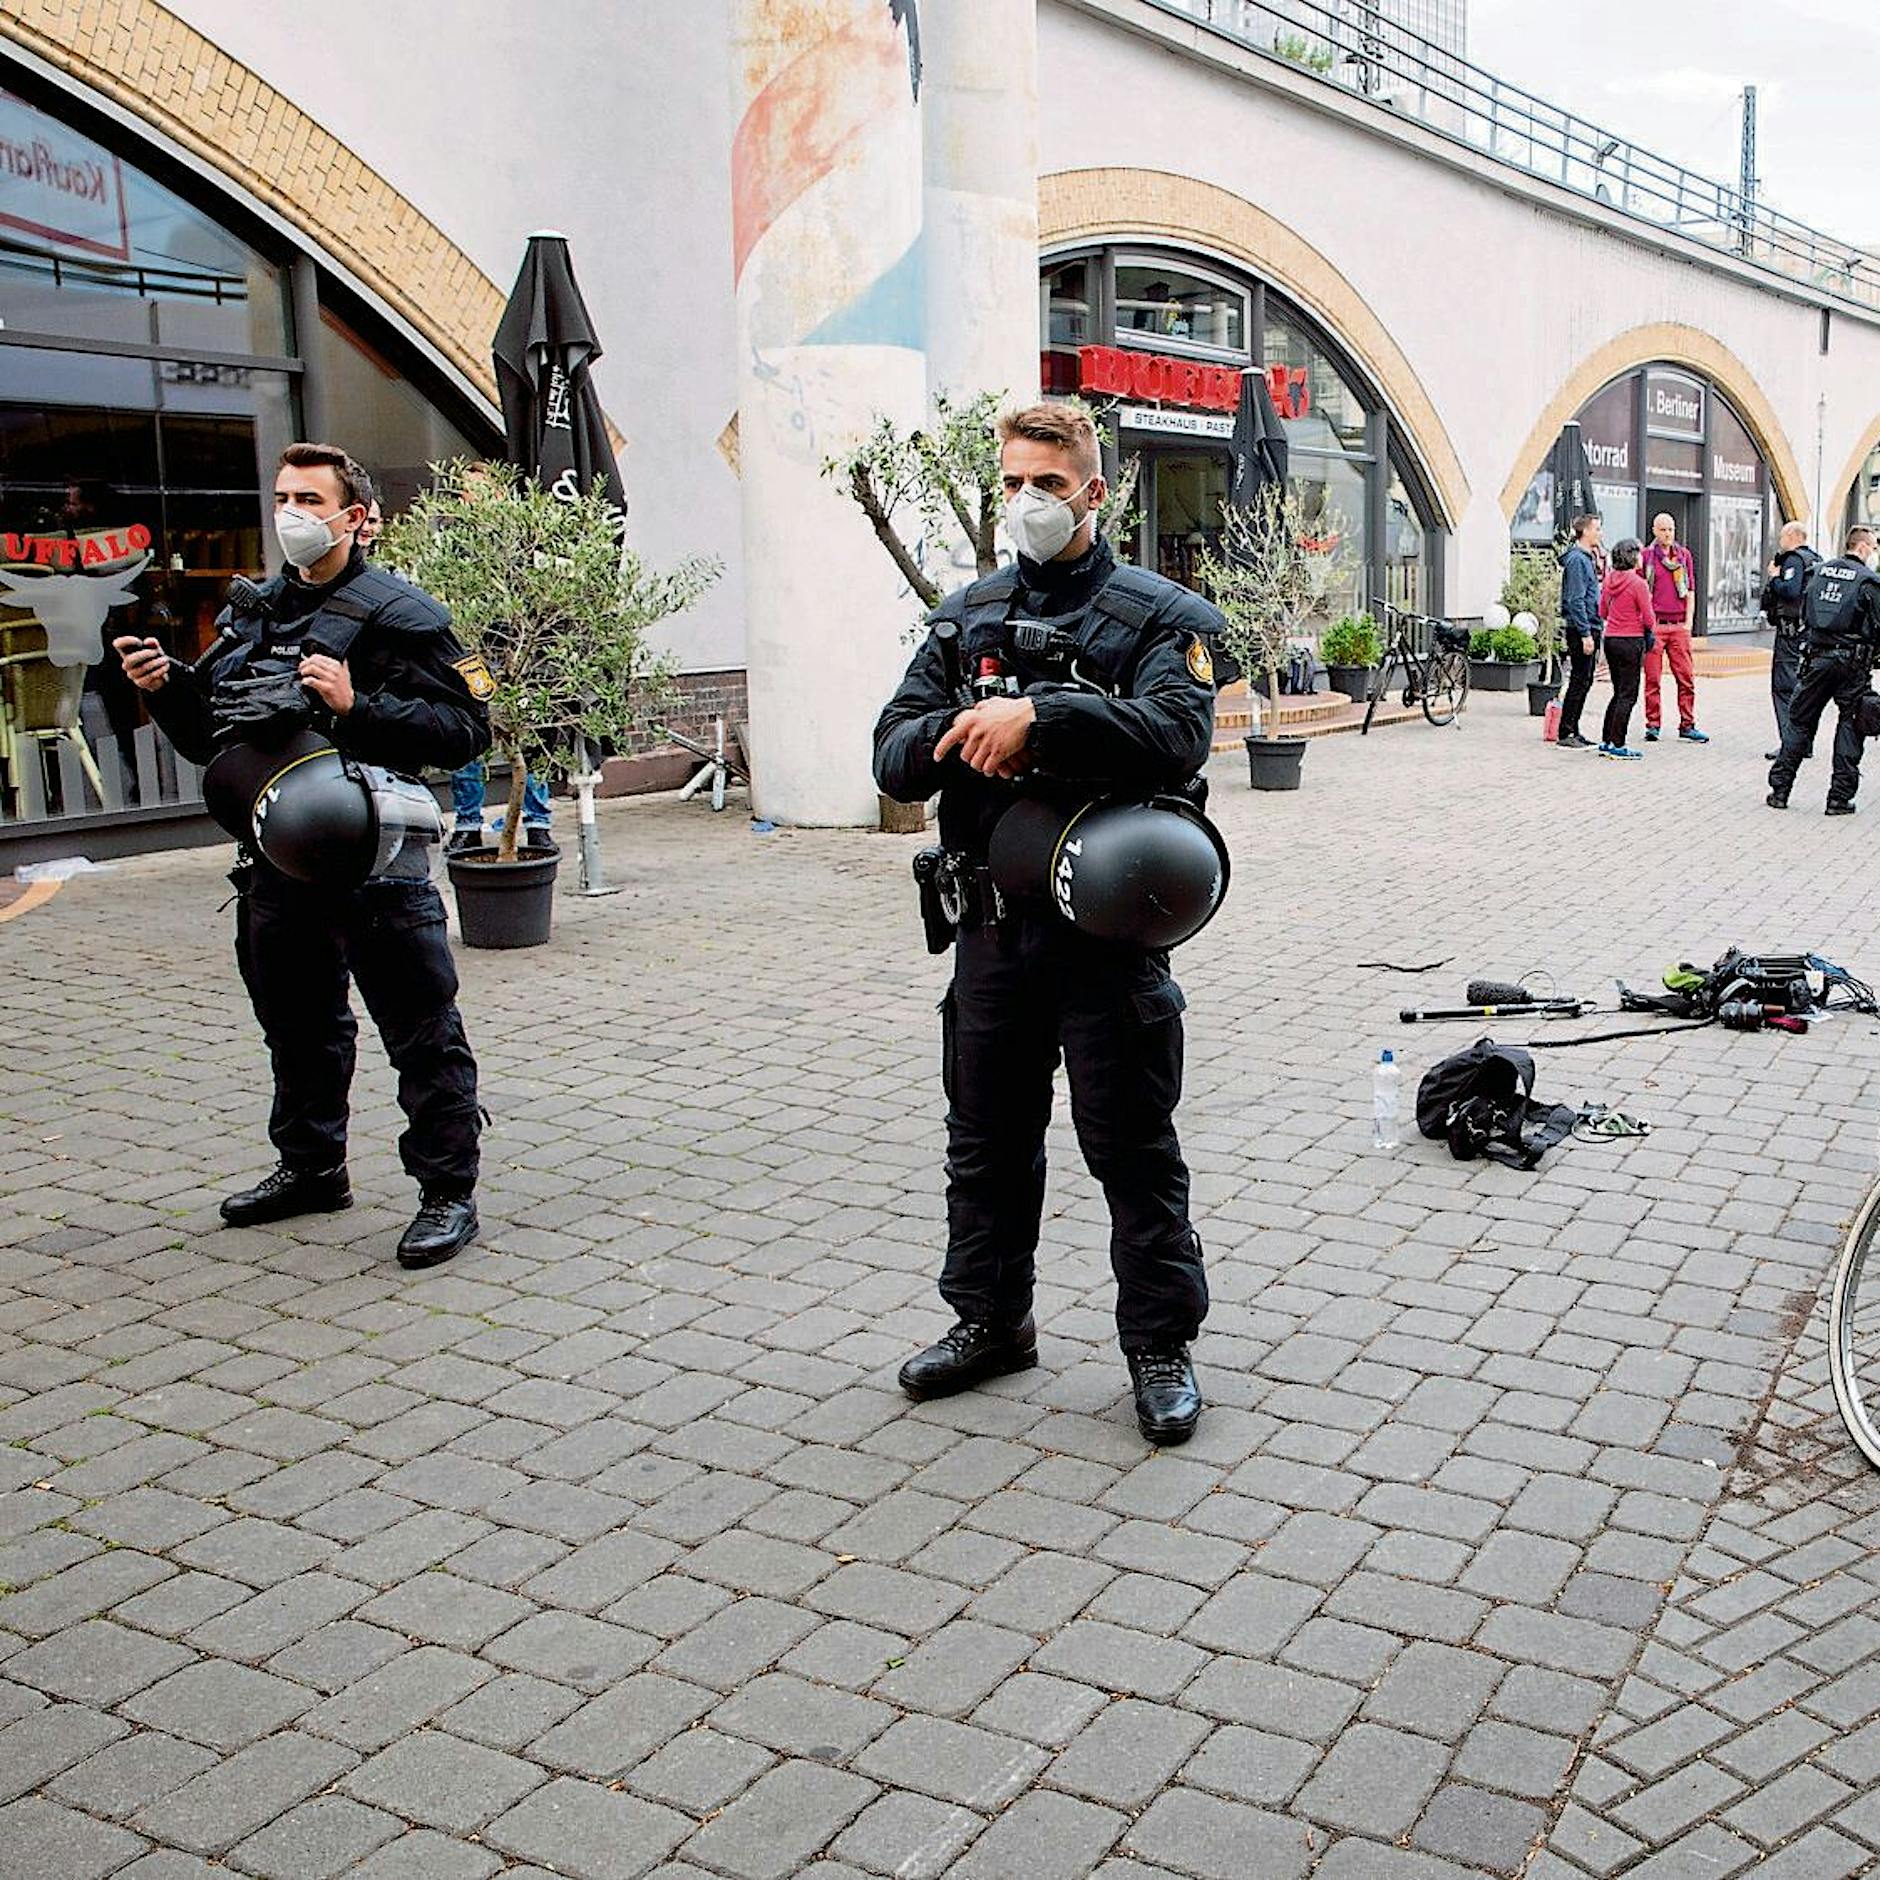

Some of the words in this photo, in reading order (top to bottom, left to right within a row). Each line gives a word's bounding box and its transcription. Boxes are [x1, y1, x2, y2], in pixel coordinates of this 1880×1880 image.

[1656, 389, 1699, 421] Berliner
[1134, 412, 1198, 430] STEAKHAUS
[1206, 420, 1233, 435] PAST
[1582, 438, 1629, 469] torrad
[1713, 454, 1756, 483] Museum
[3, 523, 152, 567] UFFALO
[1819, 565, 1858, 581] POLIZEI
